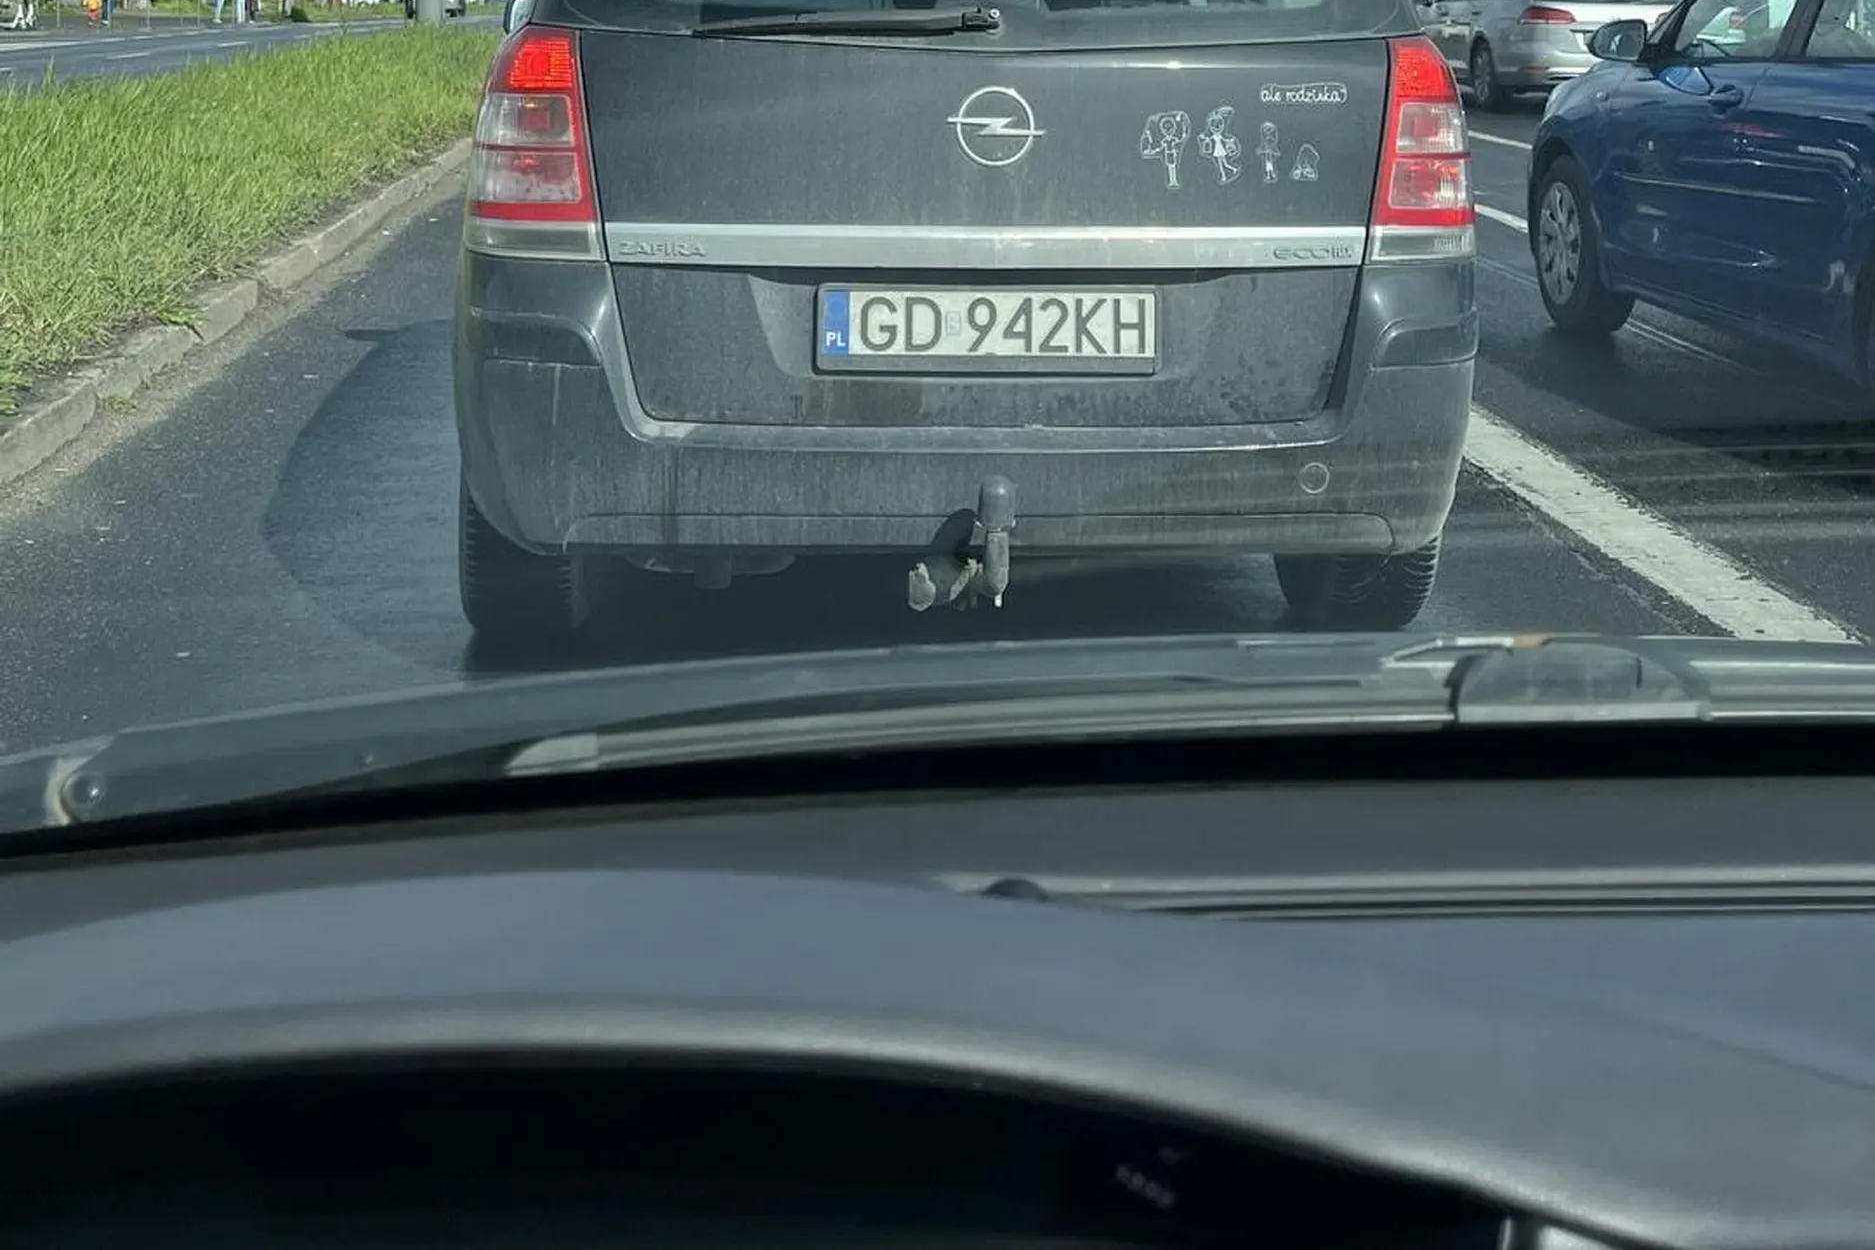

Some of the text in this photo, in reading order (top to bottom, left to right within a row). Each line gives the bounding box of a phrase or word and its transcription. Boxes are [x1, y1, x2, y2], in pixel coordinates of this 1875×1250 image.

[619, 241, 706, 258] ZAFIRA
[860, 296, 1146, 354] GD 942KH
[826, 332, 846, 347] PL
